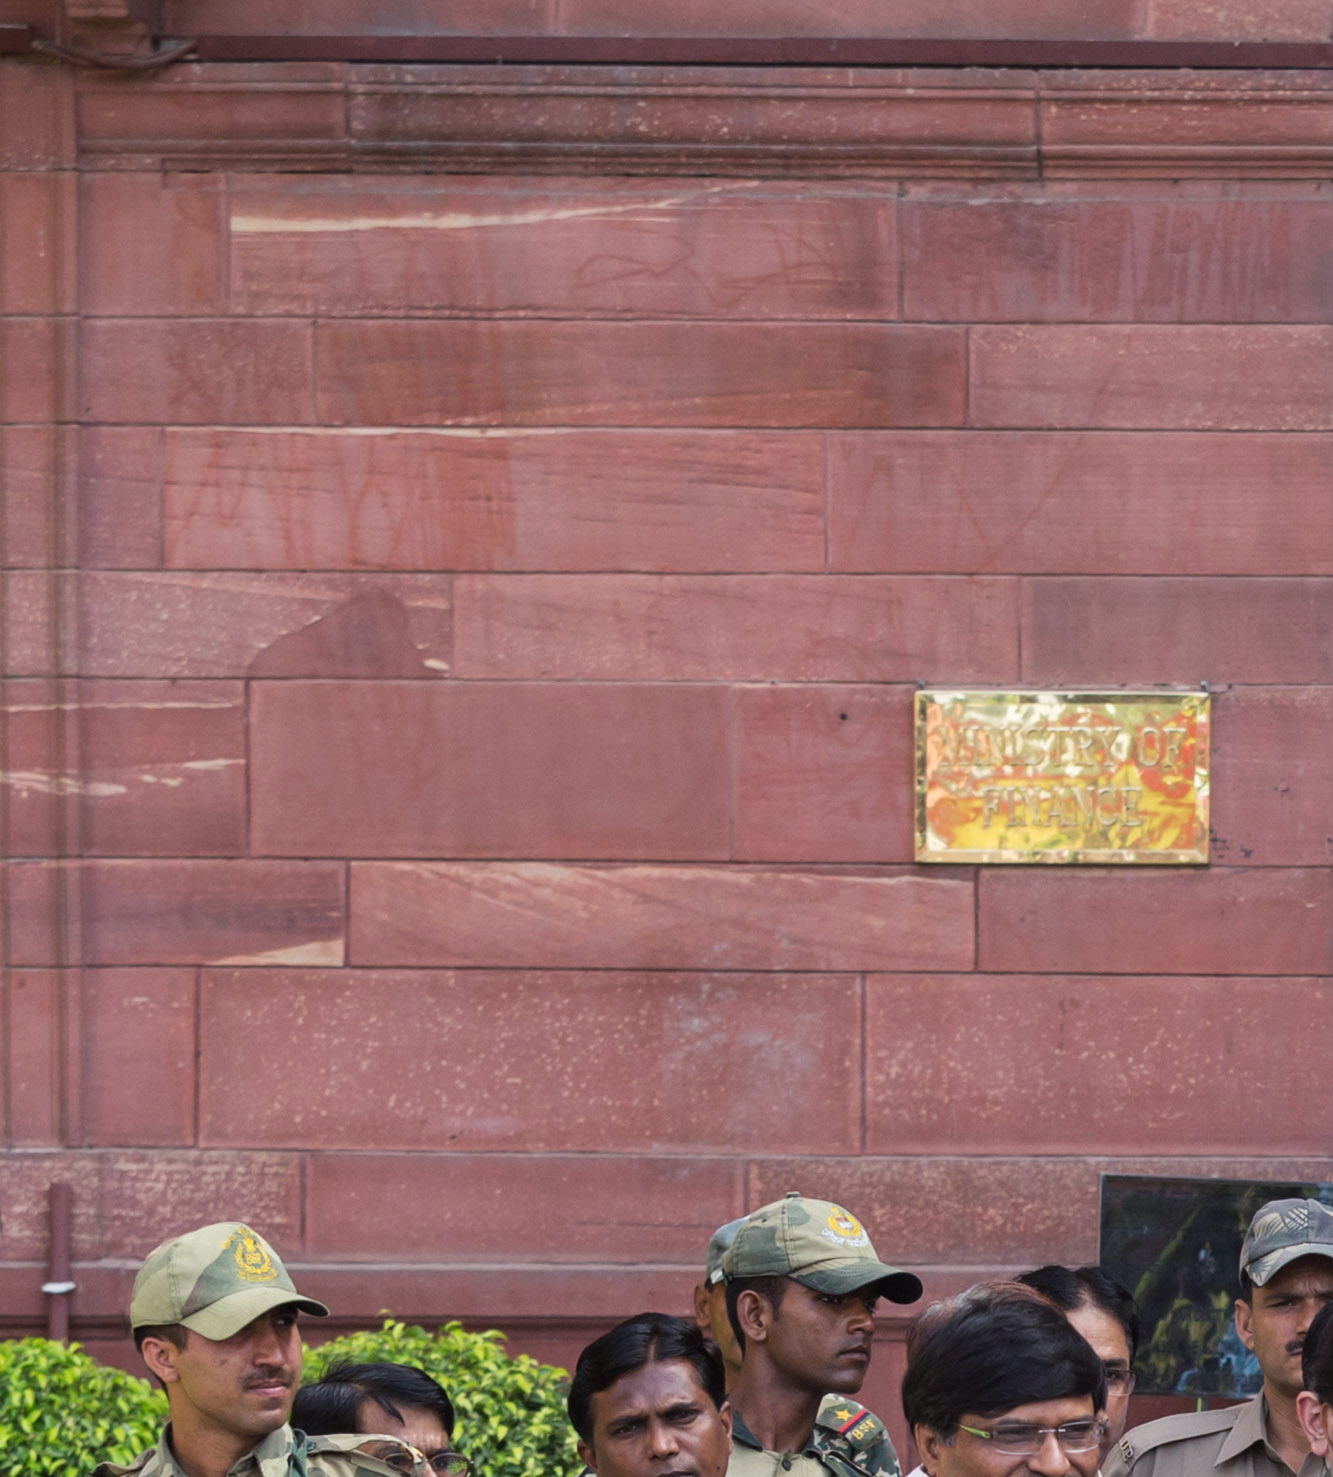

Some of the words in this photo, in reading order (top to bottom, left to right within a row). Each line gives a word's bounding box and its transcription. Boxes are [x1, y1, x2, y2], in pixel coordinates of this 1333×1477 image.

[938, 725, 1122, 768] MINISTRY
[1137, 726, 1187, 768] OF
[981, 786, 1144, 828] FINANCE
[852, 1418, 876, 1440] BSF
